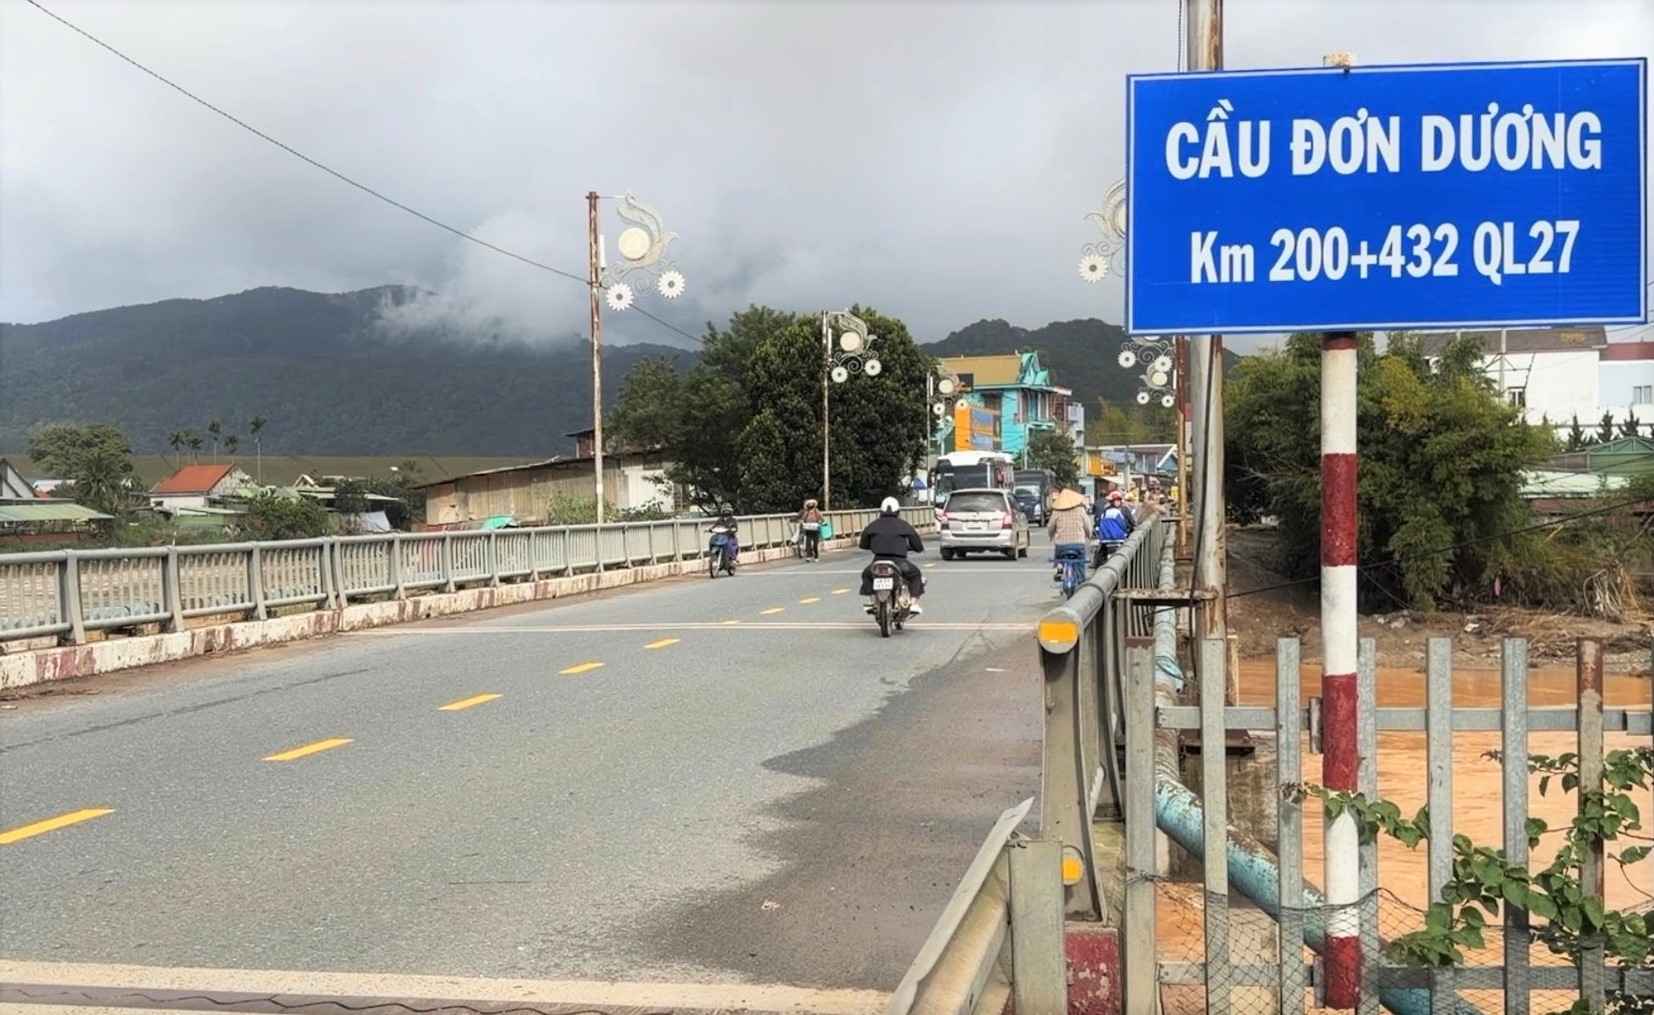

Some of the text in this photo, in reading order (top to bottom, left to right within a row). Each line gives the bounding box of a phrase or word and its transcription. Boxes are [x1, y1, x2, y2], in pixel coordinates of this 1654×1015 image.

[1166, 99, 1602, 180] CẦU ĐƠN DƯƠNG
[1191, 220, 1580, 286] Km 200+432 QL27
